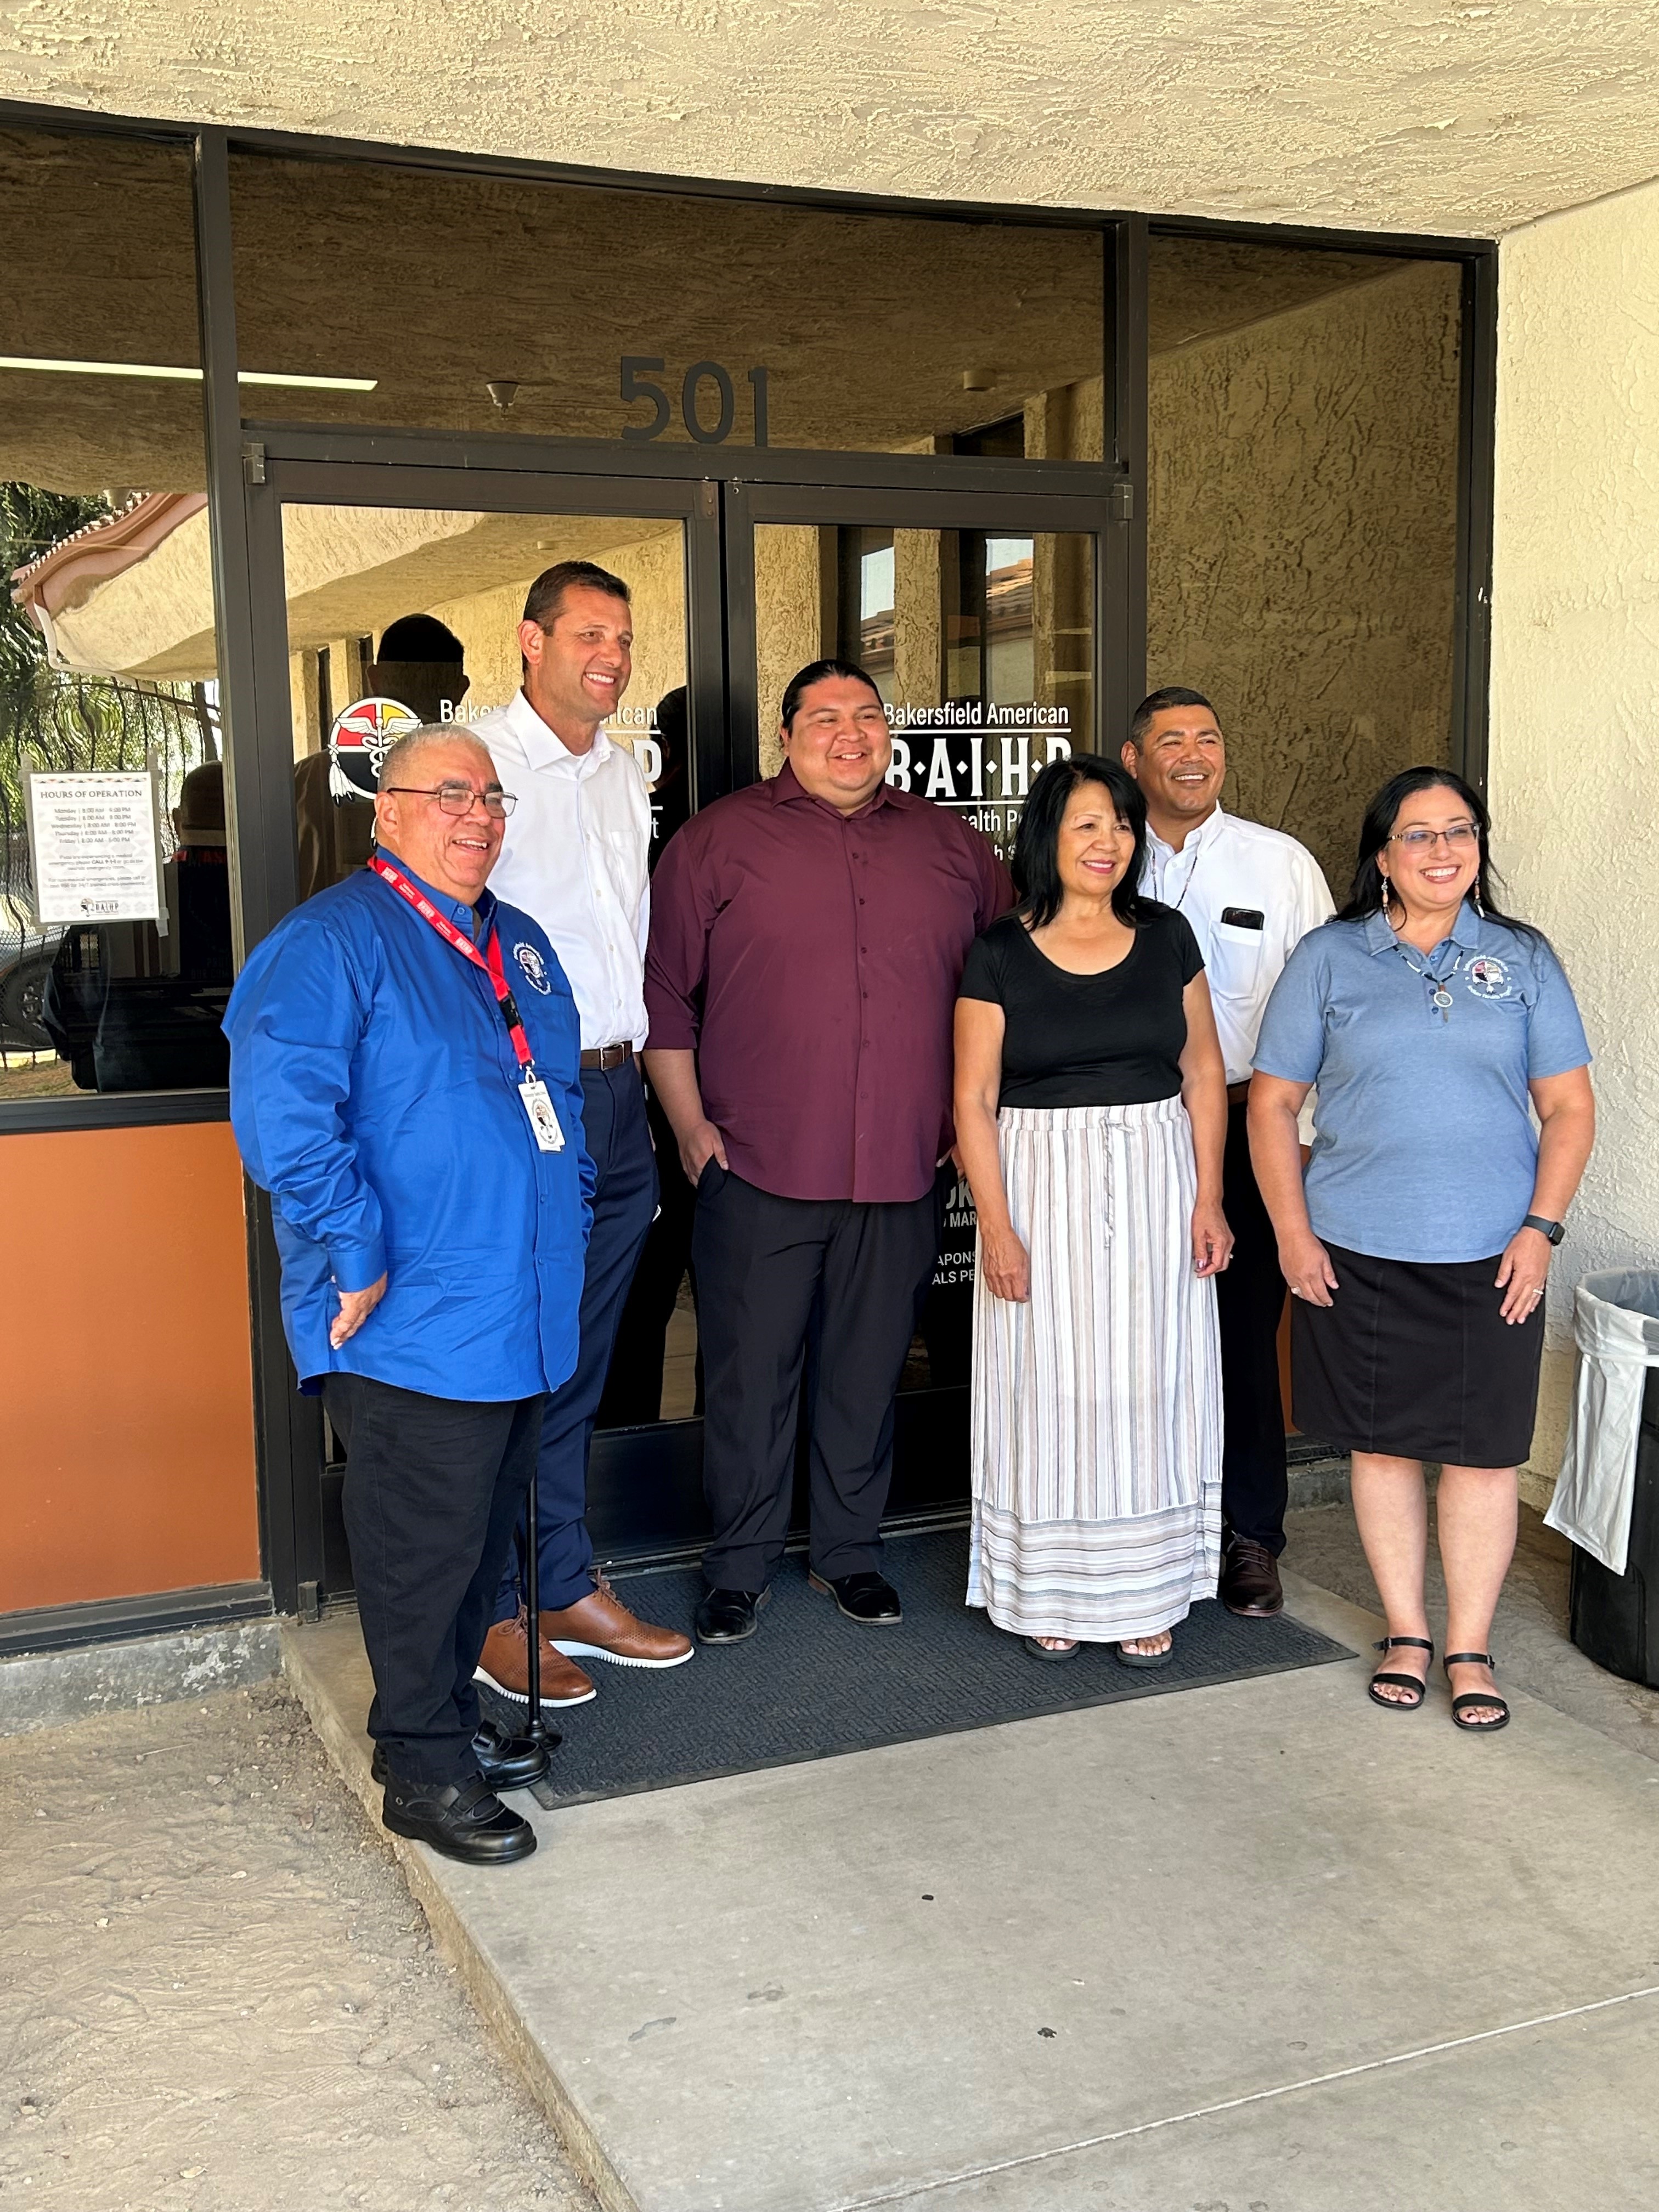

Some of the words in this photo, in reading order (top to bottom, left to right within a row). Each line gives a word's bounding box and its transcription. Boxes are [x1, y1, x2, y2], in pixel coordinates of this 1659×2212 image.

[621, 356, 768, 447] 501
[884, 701, 981, 725] Bakersfield
[986, 701, 1069, 725] American
[961, 809, 1001, 832] alth
